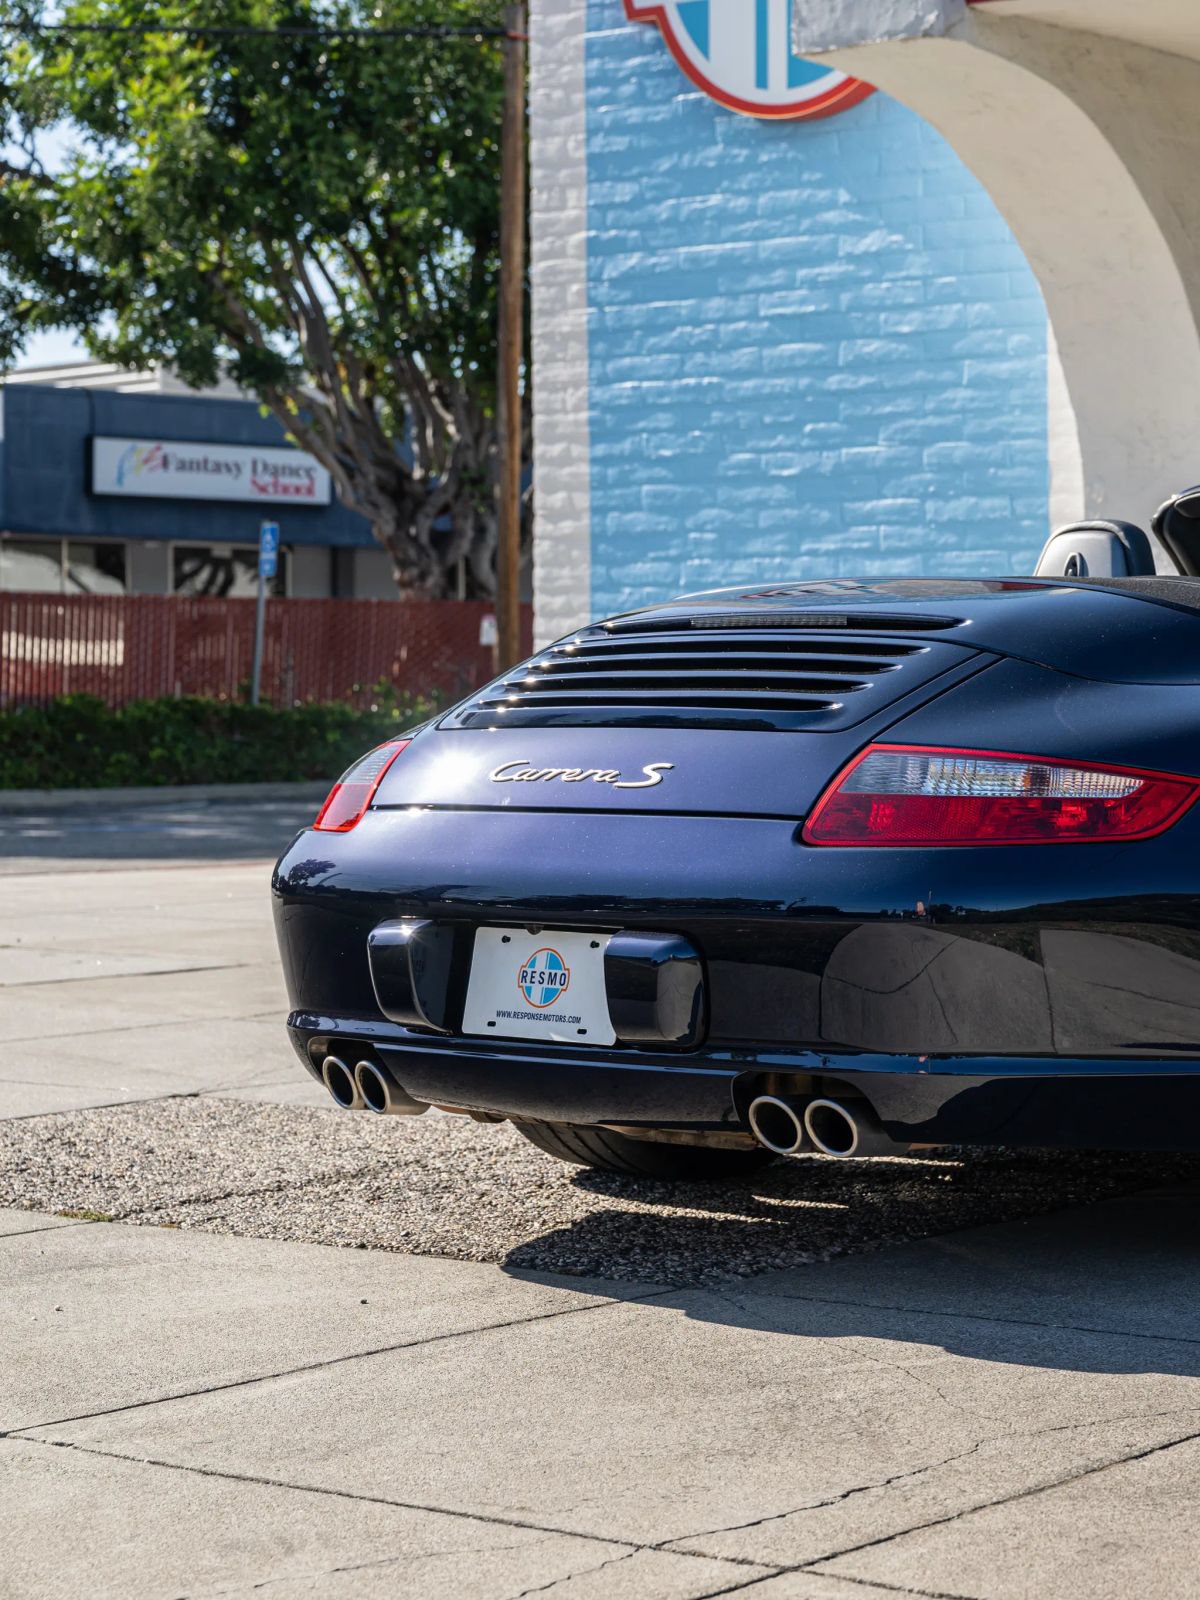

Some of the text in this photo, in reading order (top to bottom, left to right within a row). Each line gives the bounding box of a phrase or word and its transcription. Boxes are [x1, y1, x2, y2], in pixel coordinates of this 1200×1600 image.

[161, 454, 318, 480] Fantasy Dance
[250, 477, 315, 497] School
[489, 759, 676, 788] Carrera S
[520, 969, 567, 986] RESMO
[496, 1010, 581, 1024] WWW.RESPONSEMOTORS.COM
